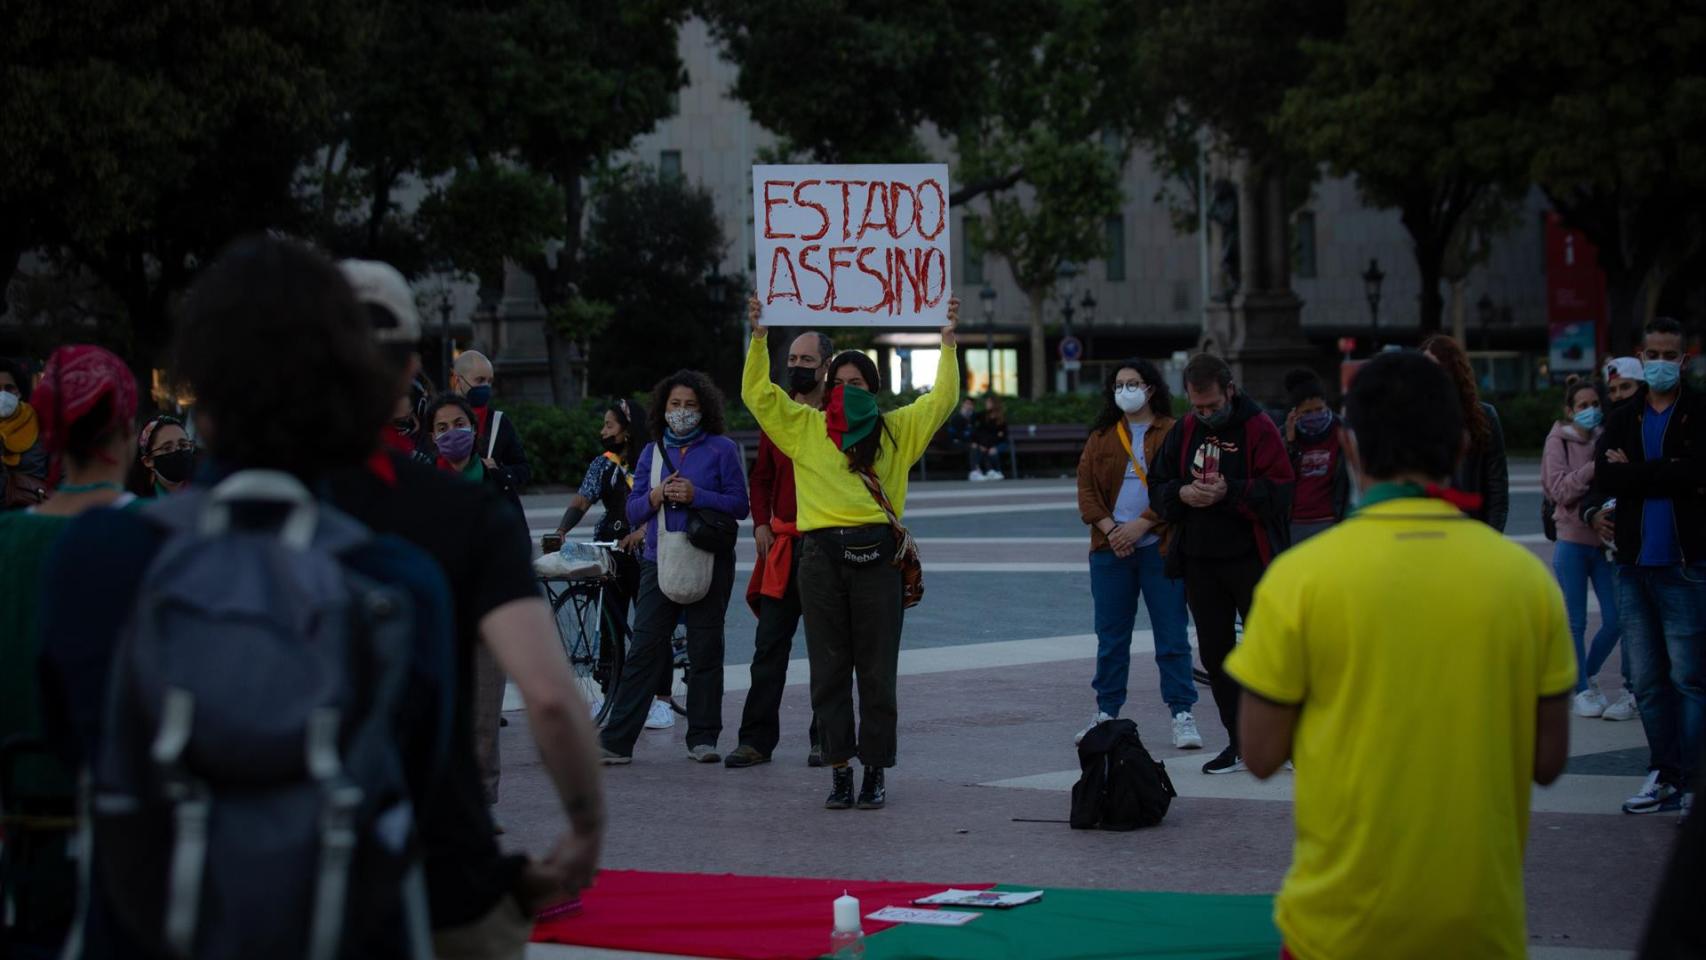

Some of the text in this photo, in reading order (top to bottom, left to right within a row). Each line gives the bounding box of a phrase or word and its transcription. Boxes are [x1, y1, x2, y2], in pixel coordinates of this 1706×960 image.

[764, 178, 945, 242] ESTADO
[767, 245, 946, 316] ASESINO
[844, 549, 880, 562] Reebok
